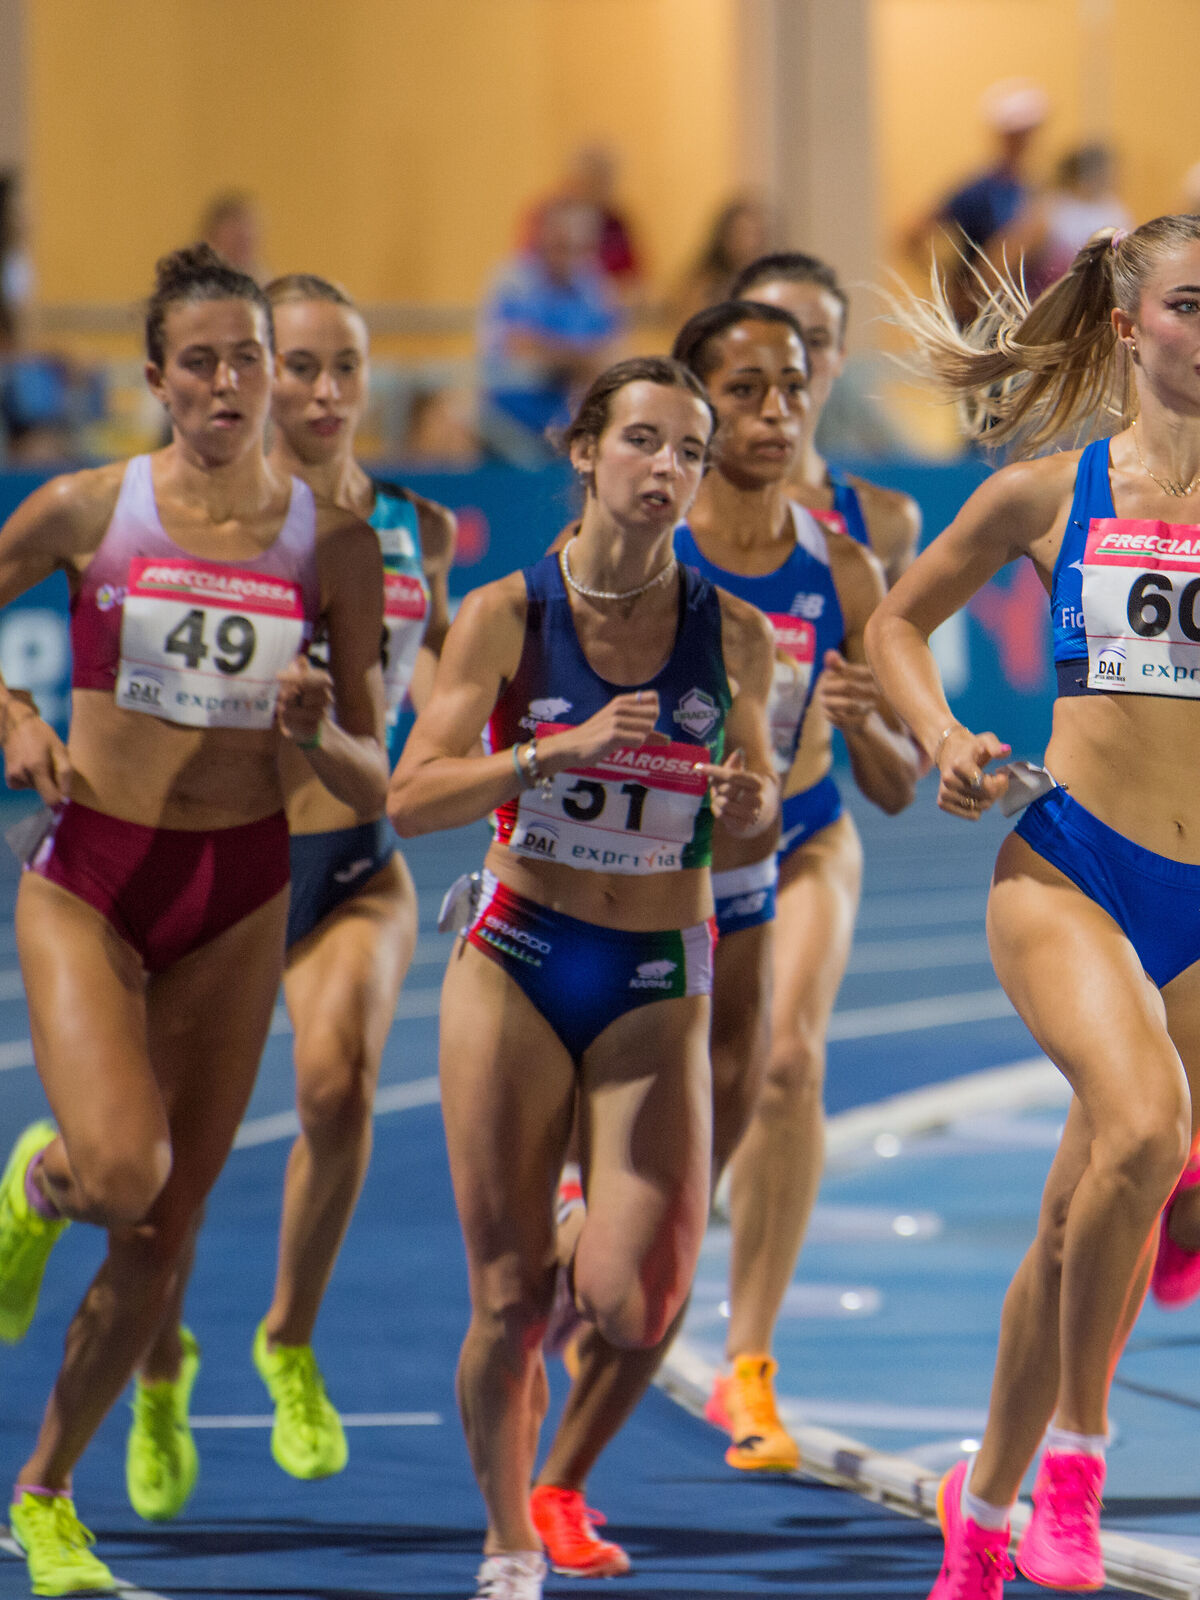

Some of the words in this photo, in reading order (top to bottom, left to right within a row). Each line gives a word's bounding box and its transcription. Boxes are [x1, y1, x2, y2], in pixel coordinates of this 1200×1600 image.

[140, 566, 297, 602] FRECCIAROSSA
[165, 609, 257, 676] 49
[1098, 660, 1123, 676] DAI
[562, 779, 650, 832] 51
[524, 833, 555, 854] DAI
[571, 844, 677, 868] exprivia
